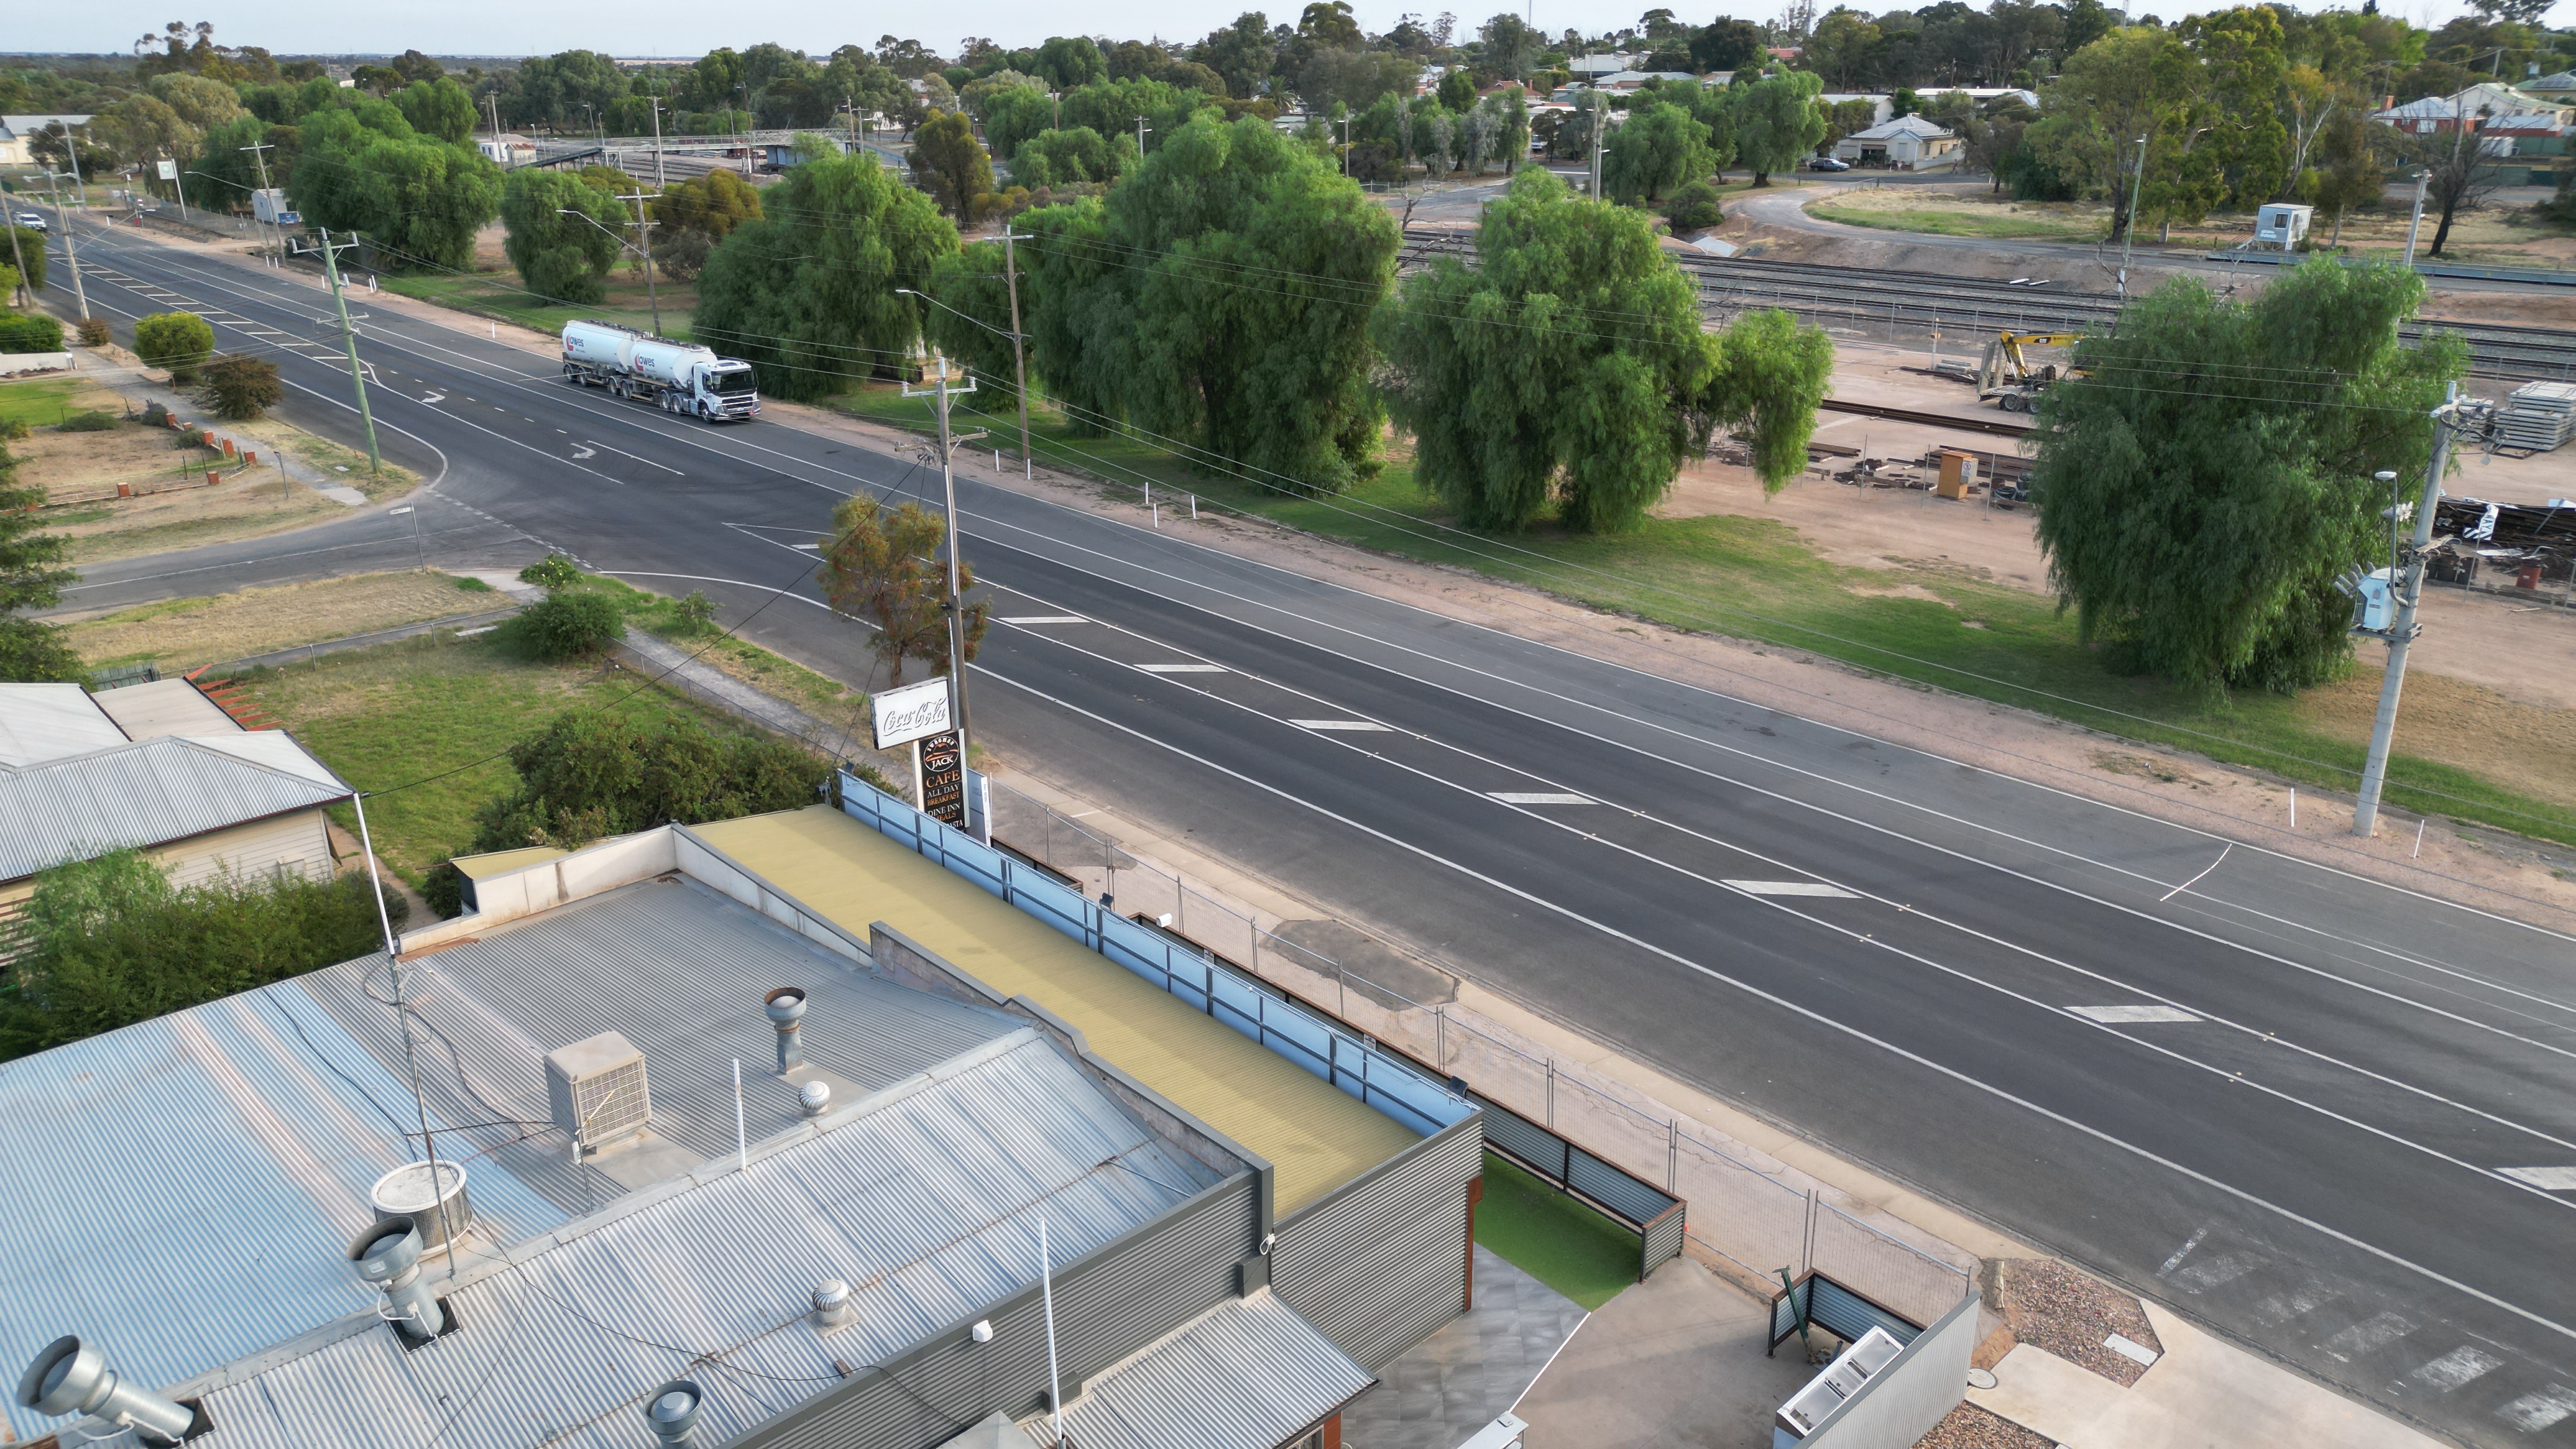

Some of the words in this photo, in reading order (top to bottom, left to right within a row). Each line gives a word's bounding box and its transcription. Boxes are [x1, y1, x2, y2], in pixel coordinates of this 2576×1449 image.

[927, 737, 955, 752] SWAGMAN
[931, 756, 954, 770] JACK
[926, 770, 960, 788] CAFE
[927, 786, 942, 799] ALL
[944, 783, 960, 794] DAY
[927, 791, 960, 806] BREAKFAST
[928, 806, 946, 816] DINE
[947, 802, 961, 811] INN
[947, 819, 963, 829] ASTA
